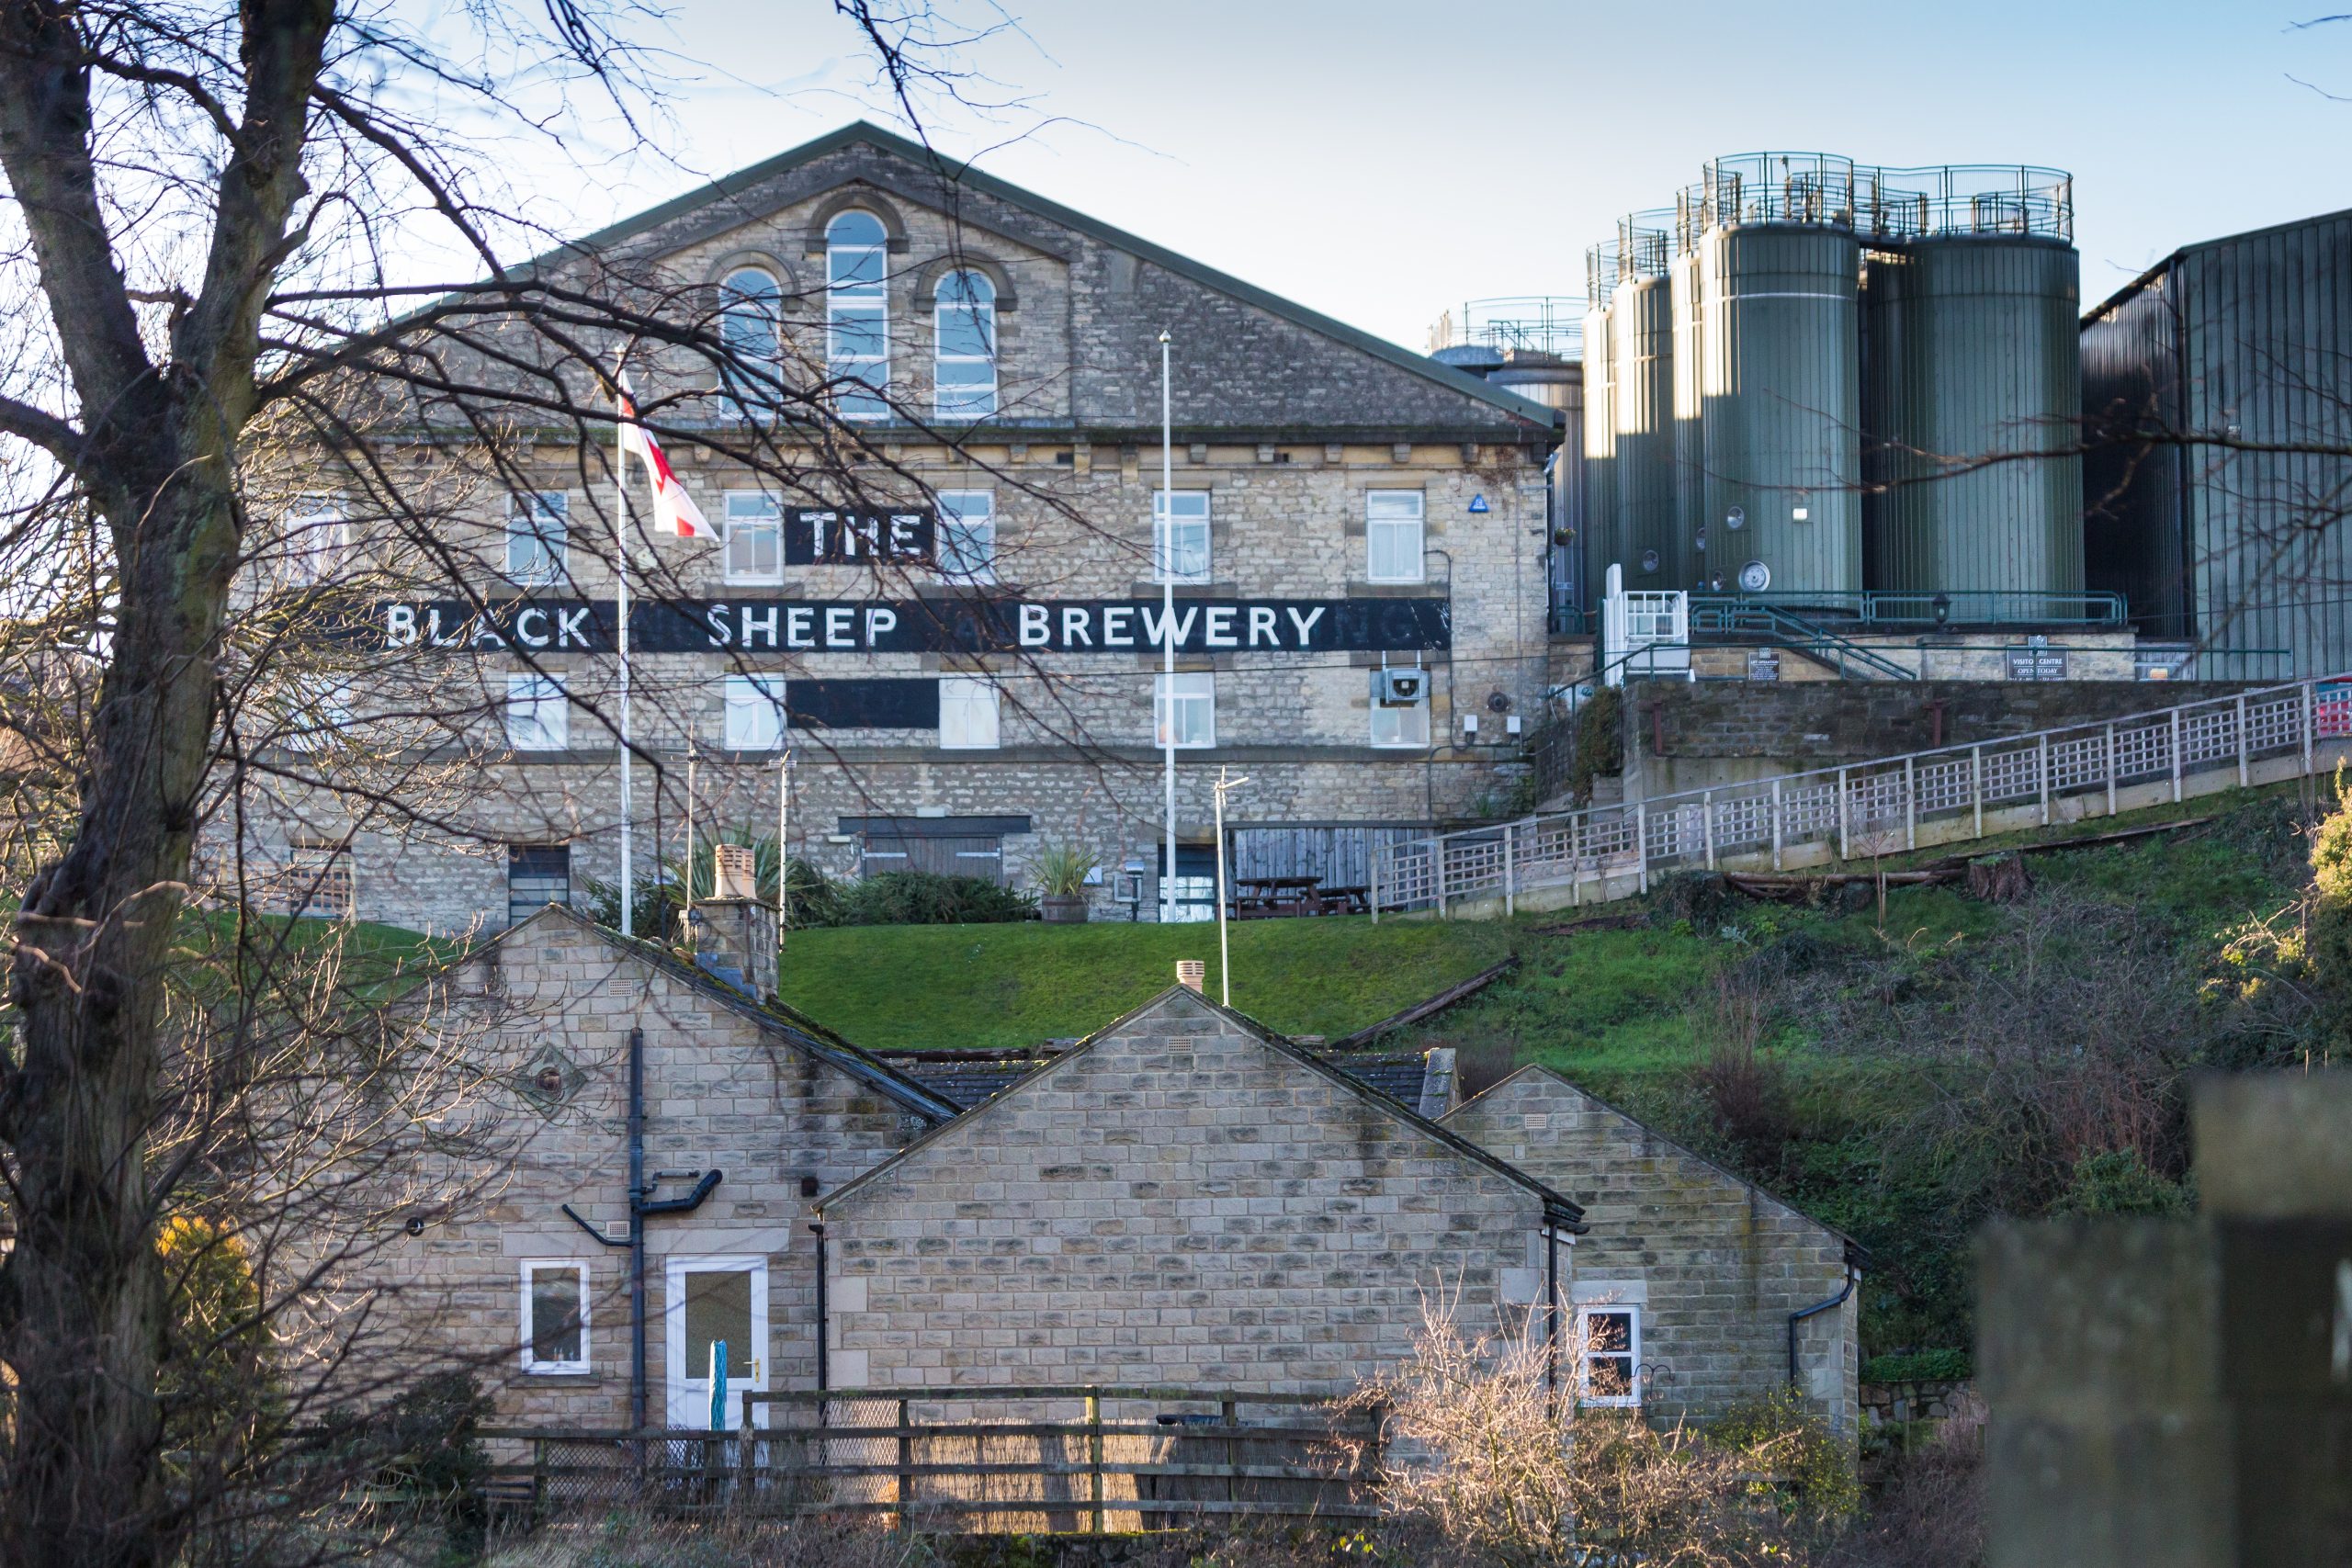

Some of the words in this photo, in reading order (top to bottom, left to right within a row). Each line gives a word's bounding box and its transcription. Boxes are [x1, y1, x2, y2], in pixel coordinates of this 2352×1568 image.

[799, 512, 921, 557] THE
[388, 604, 592, 649] BLACK
[707, 603, 898, 649] SHEEP
[1019, 604, 1326, 647] BREWERY
